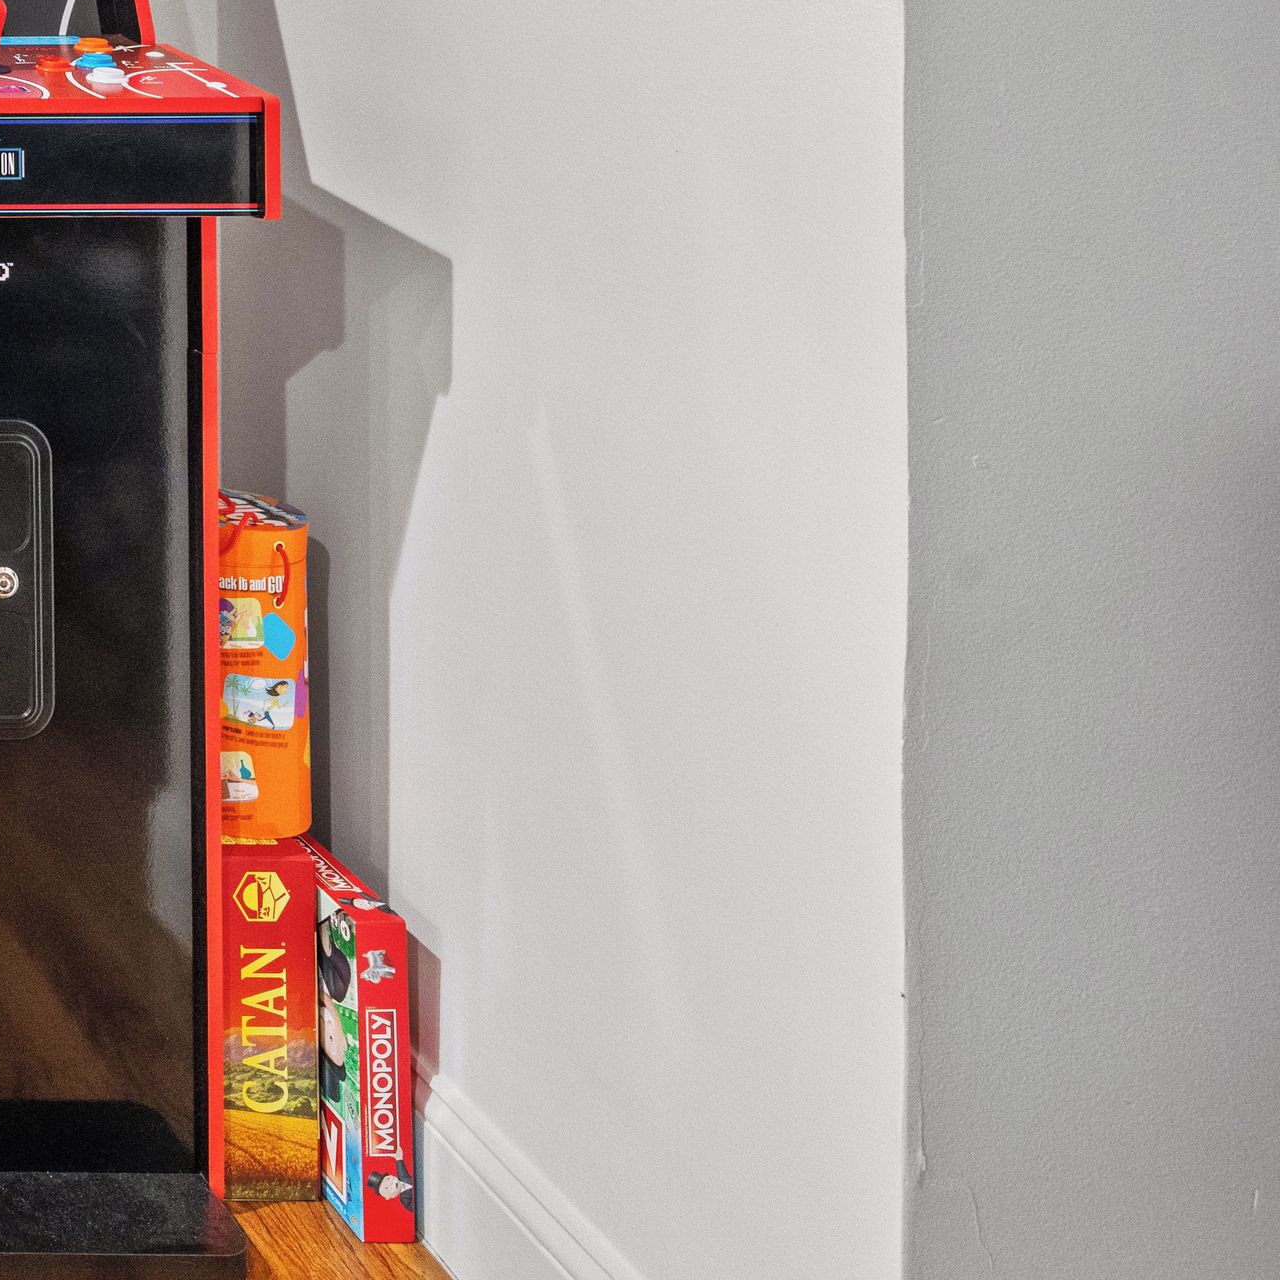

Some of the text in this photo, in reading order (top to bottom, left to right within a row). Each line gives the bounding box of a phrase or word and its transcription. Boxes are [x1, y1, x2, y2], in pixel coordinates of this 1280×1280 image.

[249, 577, 267, 591] and
[239, 946, 287, 1114] CATAN
[370, 1013, 395, 1151] MONOPOLY
